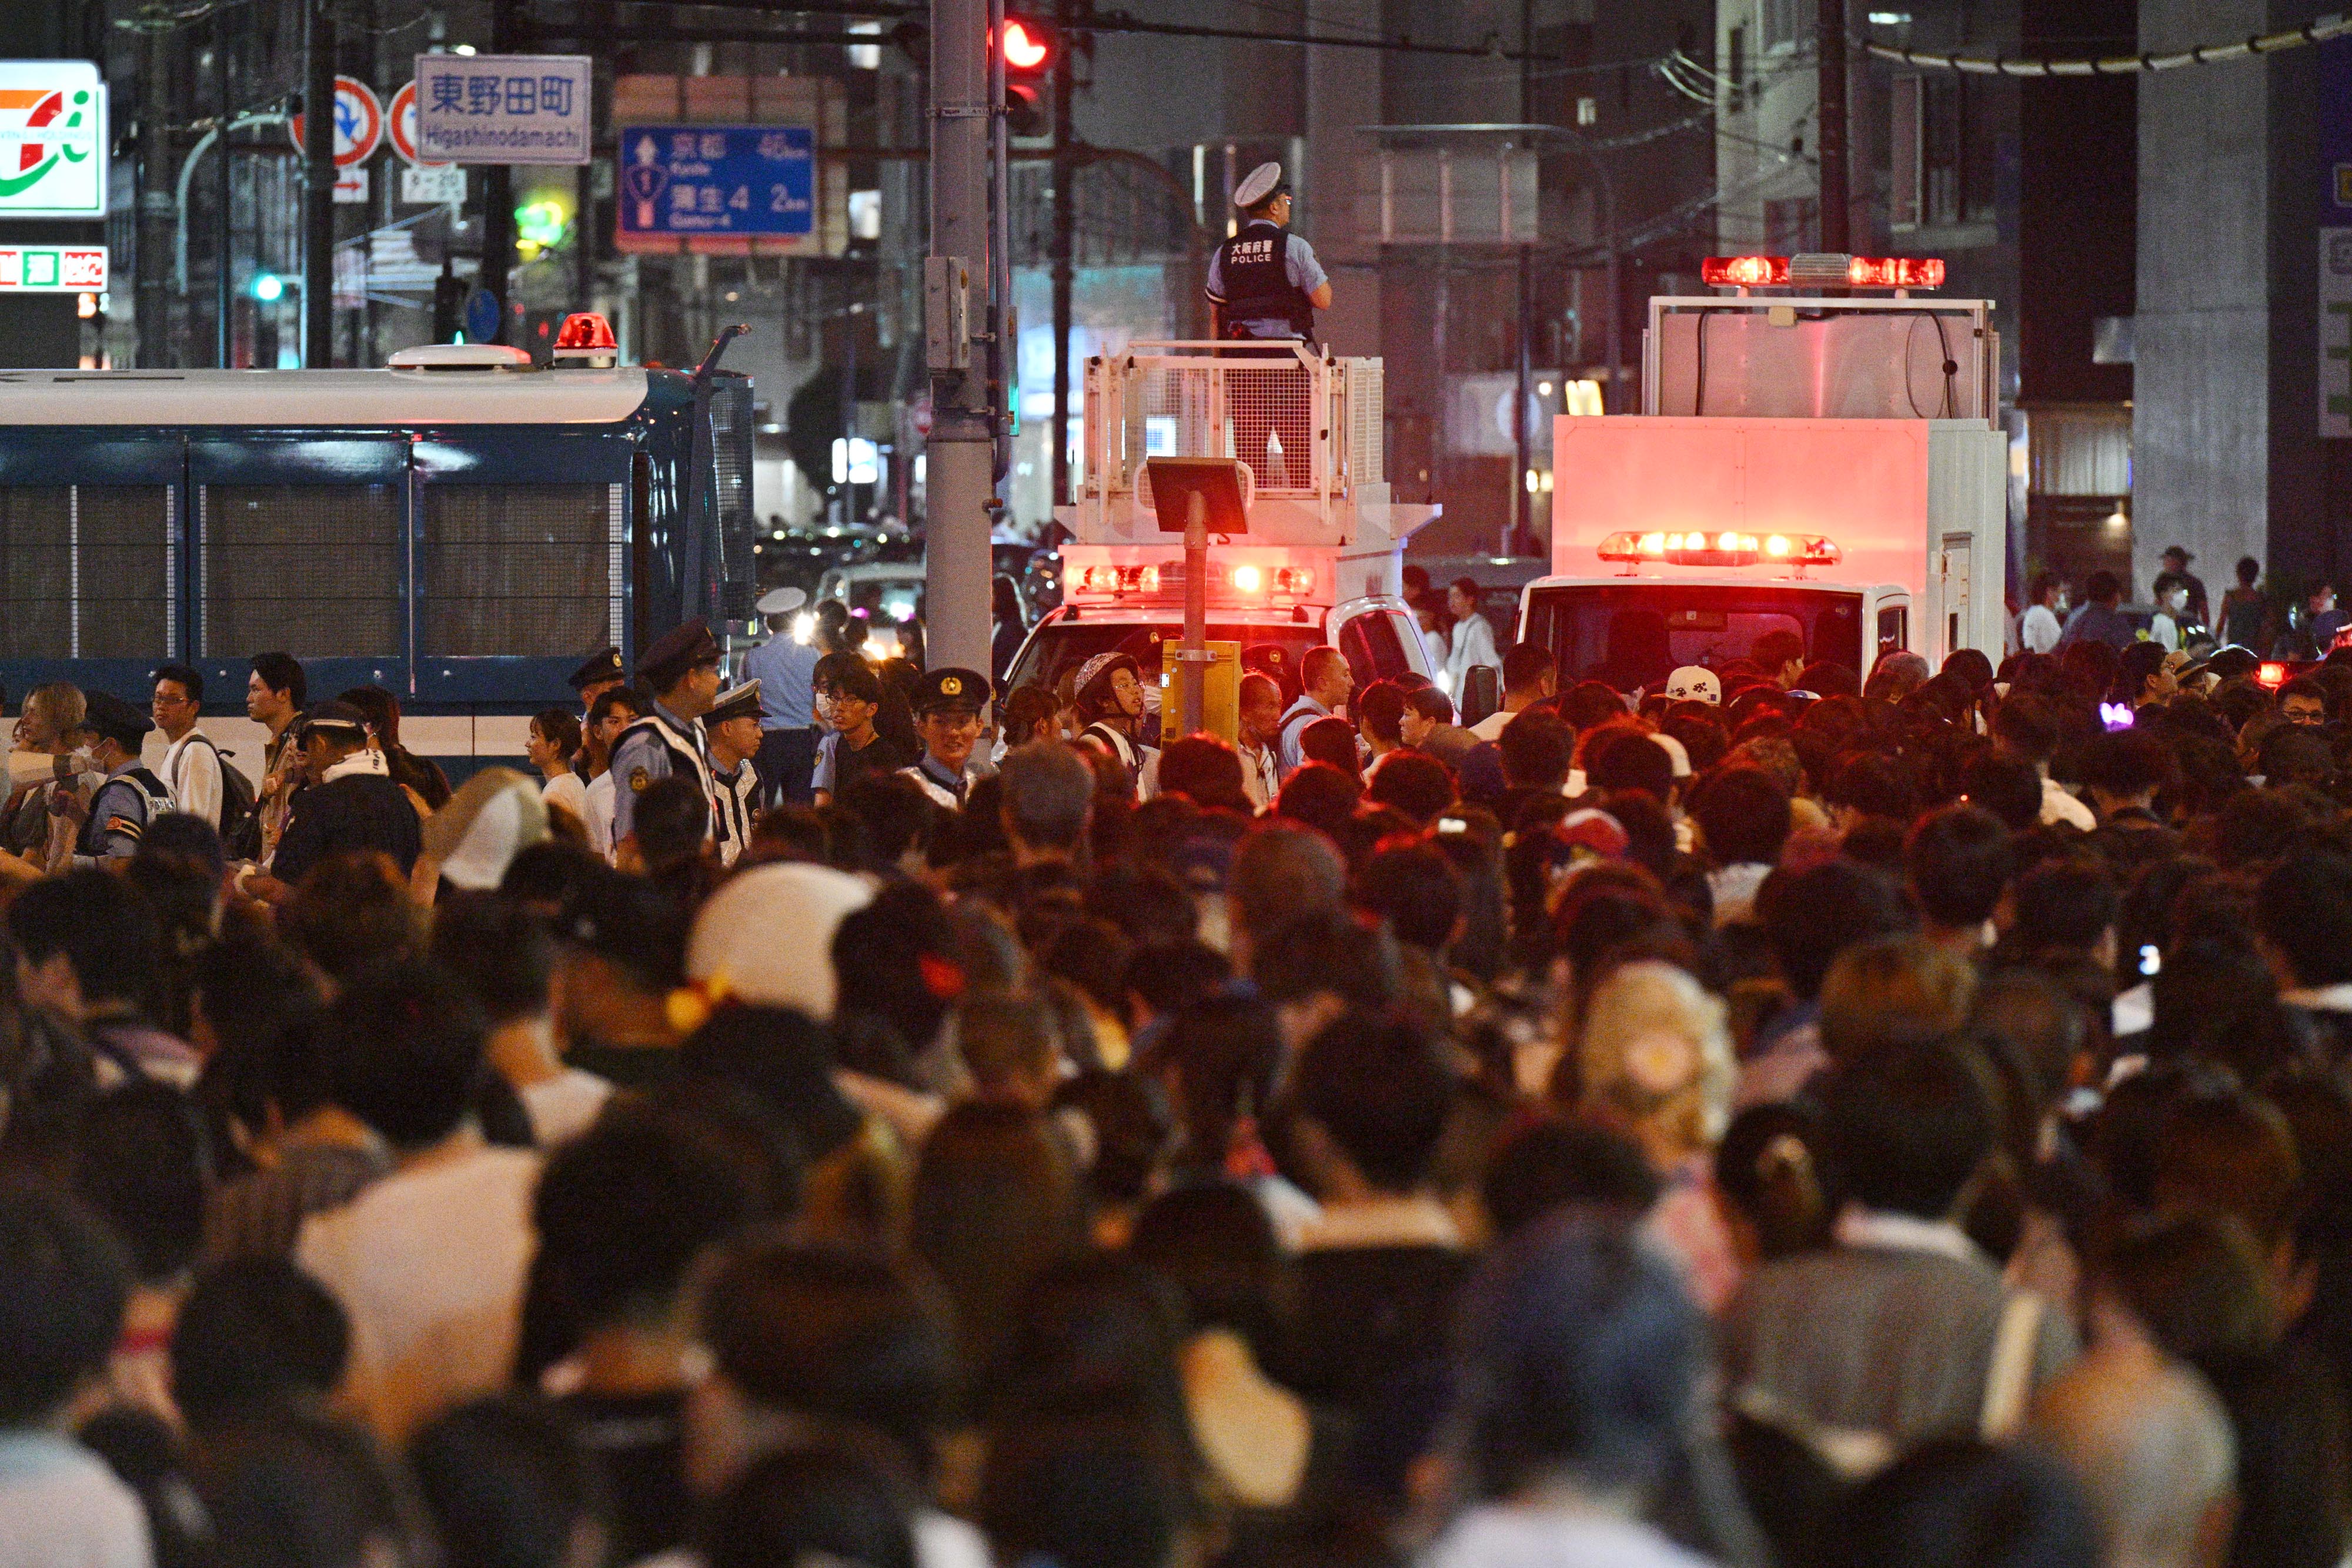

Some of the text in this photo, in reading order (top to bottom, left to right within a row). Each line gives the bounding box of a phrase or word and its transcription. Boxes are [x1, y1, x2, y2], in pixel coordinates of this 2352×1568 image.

[430, 73, 573, 116] 東野田町
[425, 123, 580, 148] Higashinodamachi
[1231, 240, 1272, 255] 大阪府警
[1231, 253, 1271, 264] POLICE
